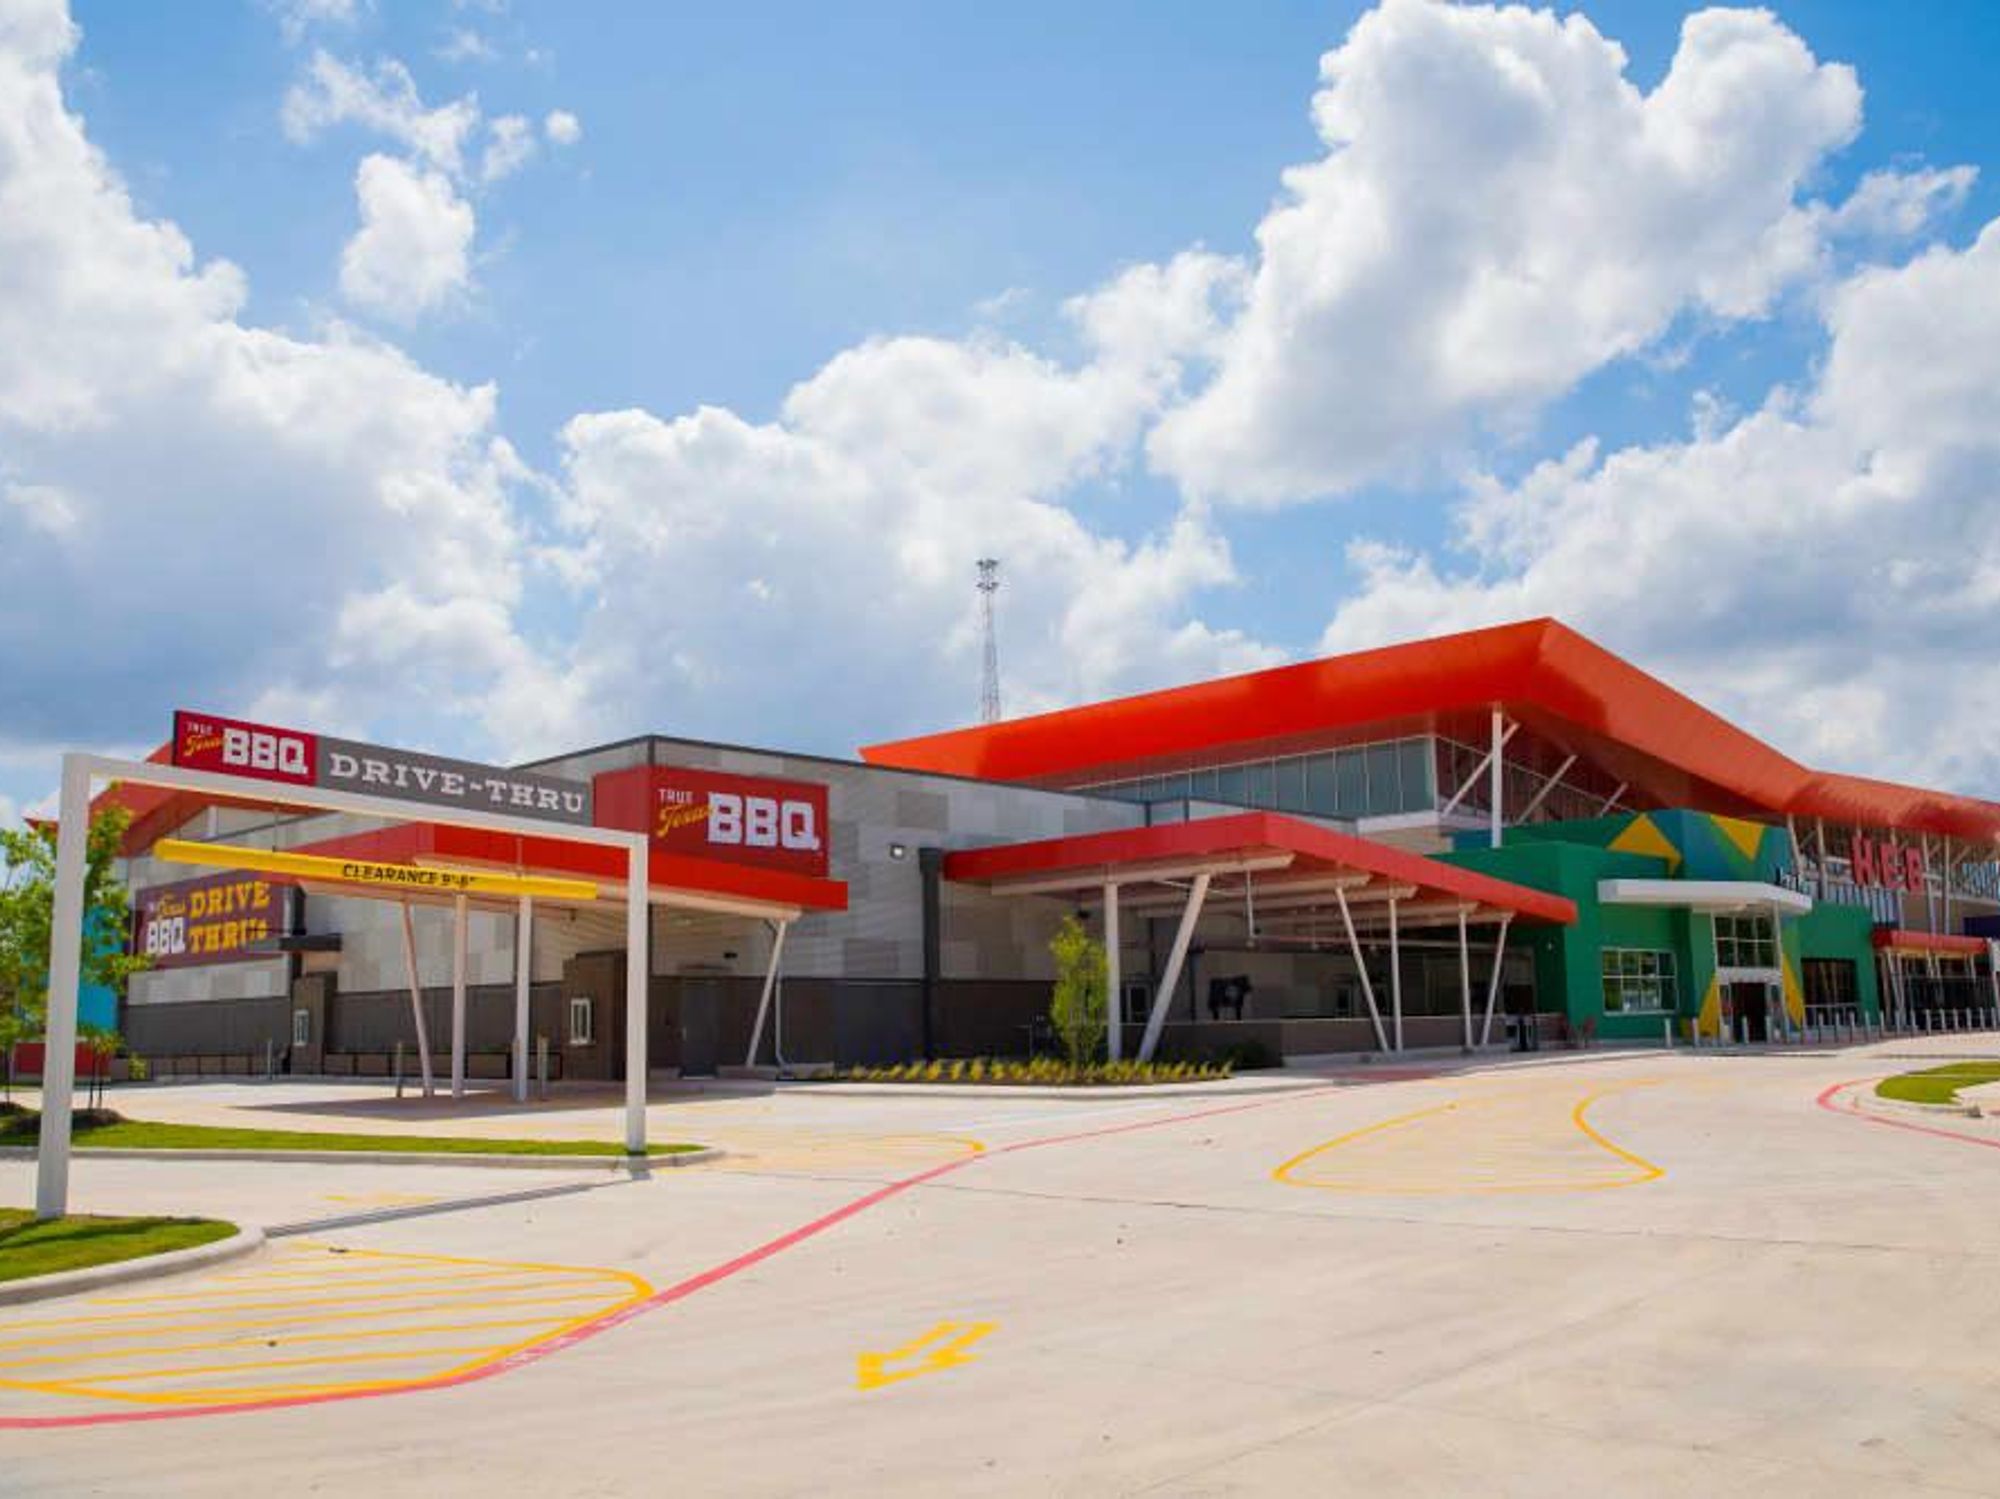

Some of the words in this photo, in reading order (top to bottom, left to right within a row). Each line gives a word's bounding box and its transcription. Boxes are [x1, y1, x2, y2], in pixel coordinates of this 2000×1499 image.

[222, 727, 308, 775] BBQ
[329, 752, 583, 813] DRIVE-THRU
[658, 788, 693, 805] TRUE
[707, 791, 819, 850] BBQ
[343, 863, 437, 885] CLEARANCE
[190, 880, 270, 919] DRIVE
[146, 917, 185, 956] BBQ
